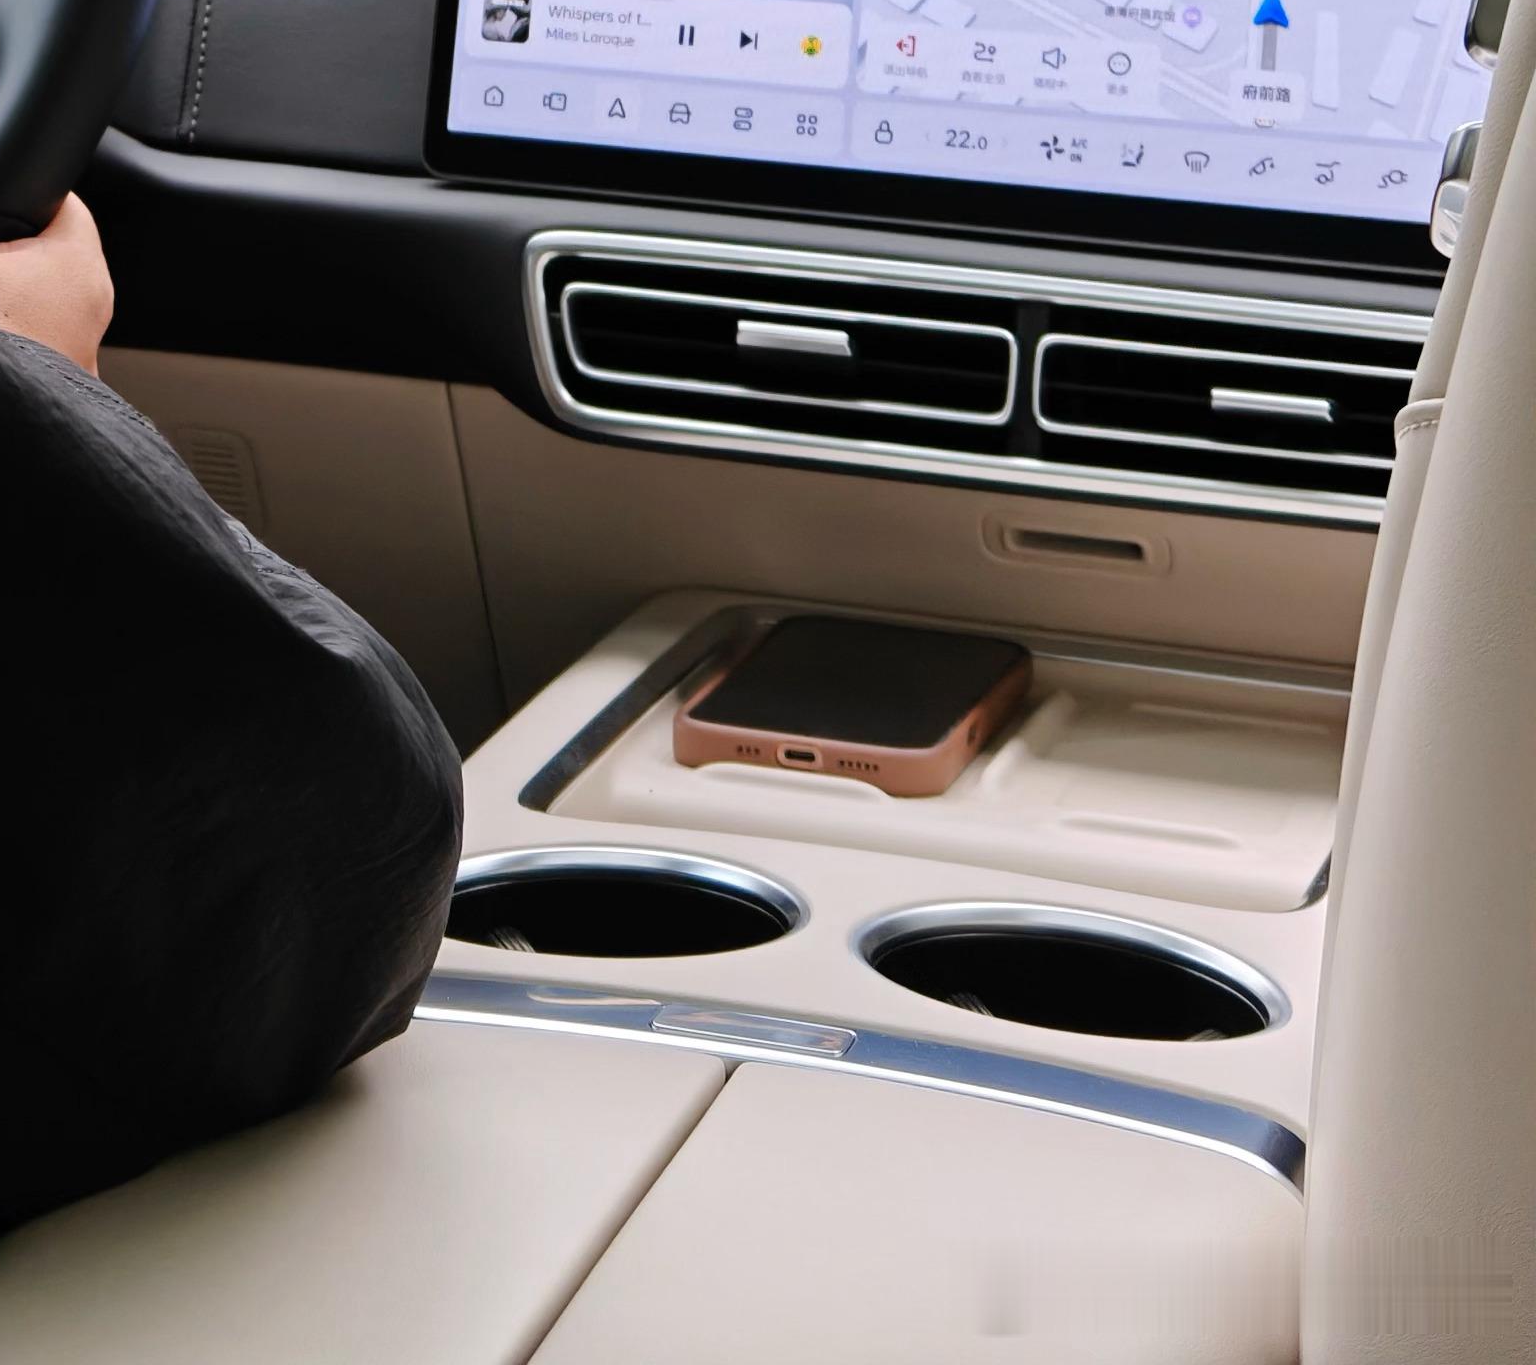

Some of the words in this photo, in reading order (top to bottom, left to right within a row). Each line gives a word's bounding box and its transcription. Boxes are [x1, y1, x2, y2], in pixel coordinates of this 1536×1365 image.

[548, 4, 614, 23] Whispers
[617, 11, 632, 24] of
[545, 27, 579, 42] Miles
[1243, 84, 1291, 103] 府前路
[944, 128, 989, 151] 22.0
